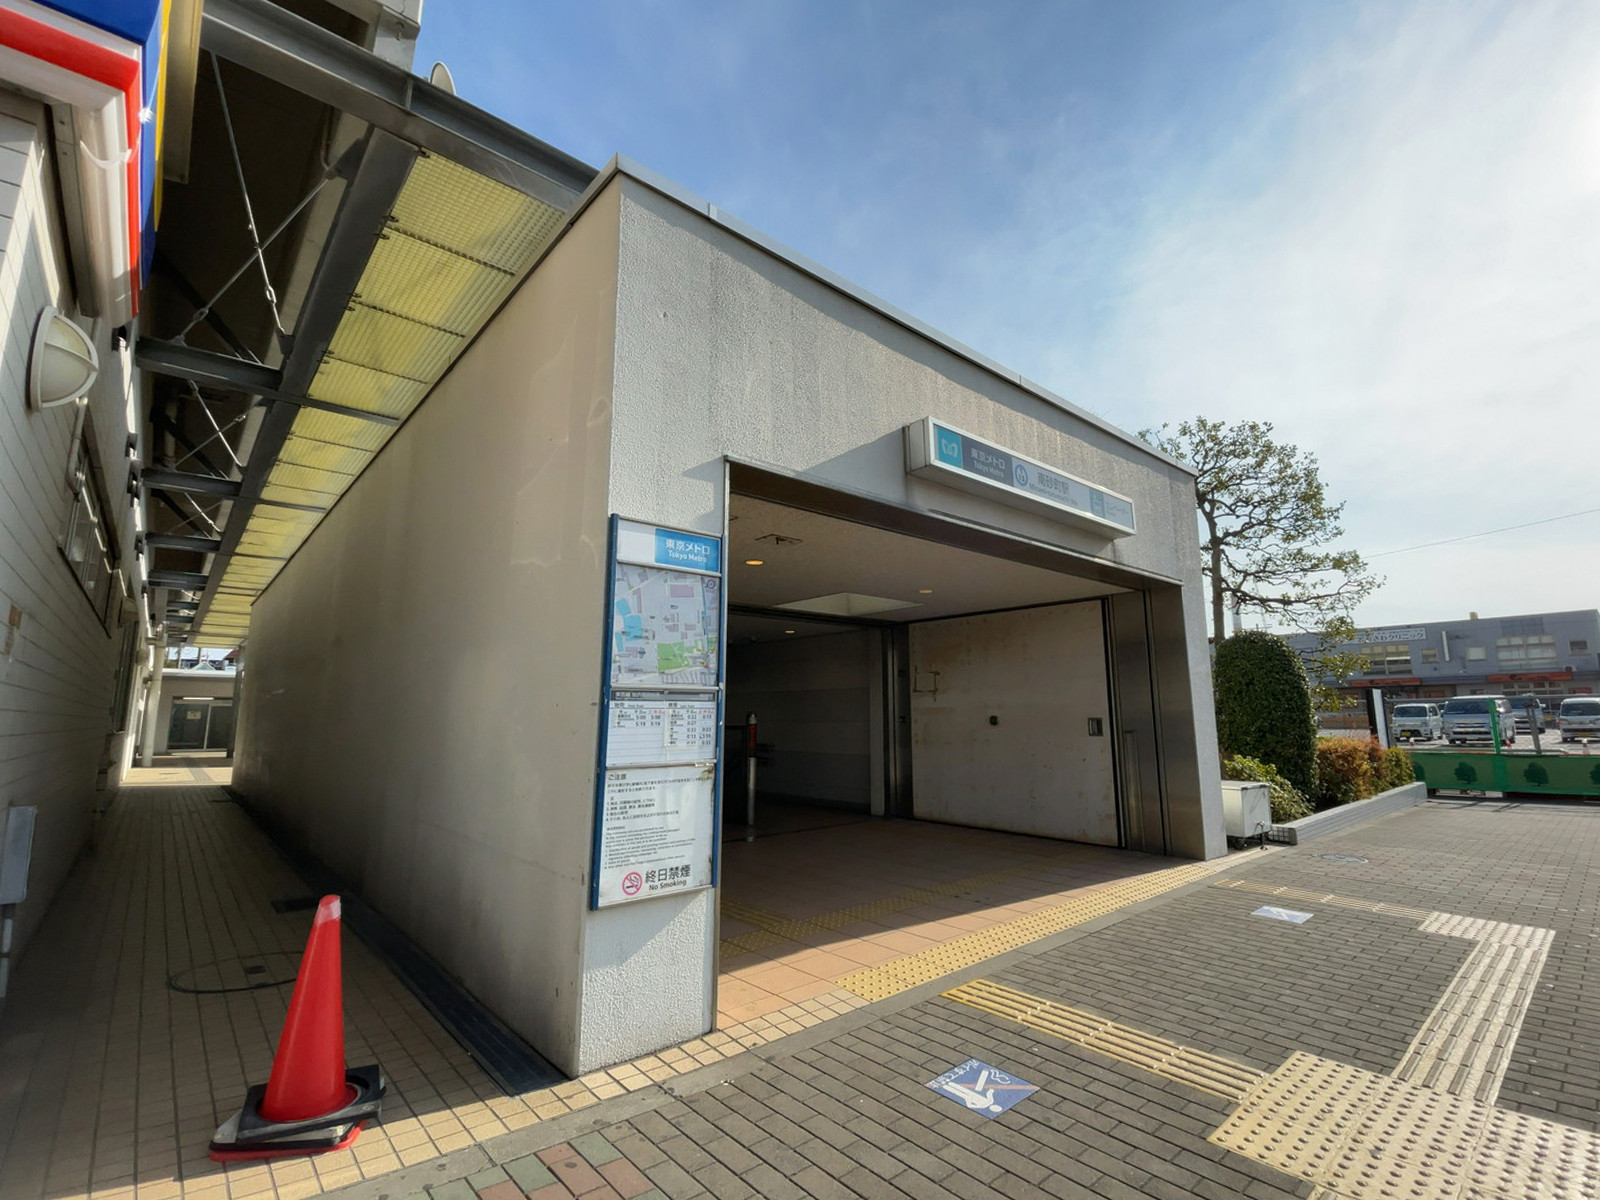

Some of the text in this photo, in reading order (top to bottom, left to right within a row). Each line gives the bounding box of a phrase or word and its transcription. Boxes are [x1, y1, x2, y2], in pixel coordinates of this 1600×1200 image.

[970, 447, 1005, 470] 東京メトロ
[973, 460, 1004, 478] Tokyo Metro
[1037, 472, 1070, 496] 南砂町駅
[665, 539, 710, 555] 東京メトロ
[668, 550, 708, 563] Tokyo Metro
[645, 864, 691, 884] 終日禁煙
[659, 879, 687, 889] Smoking
